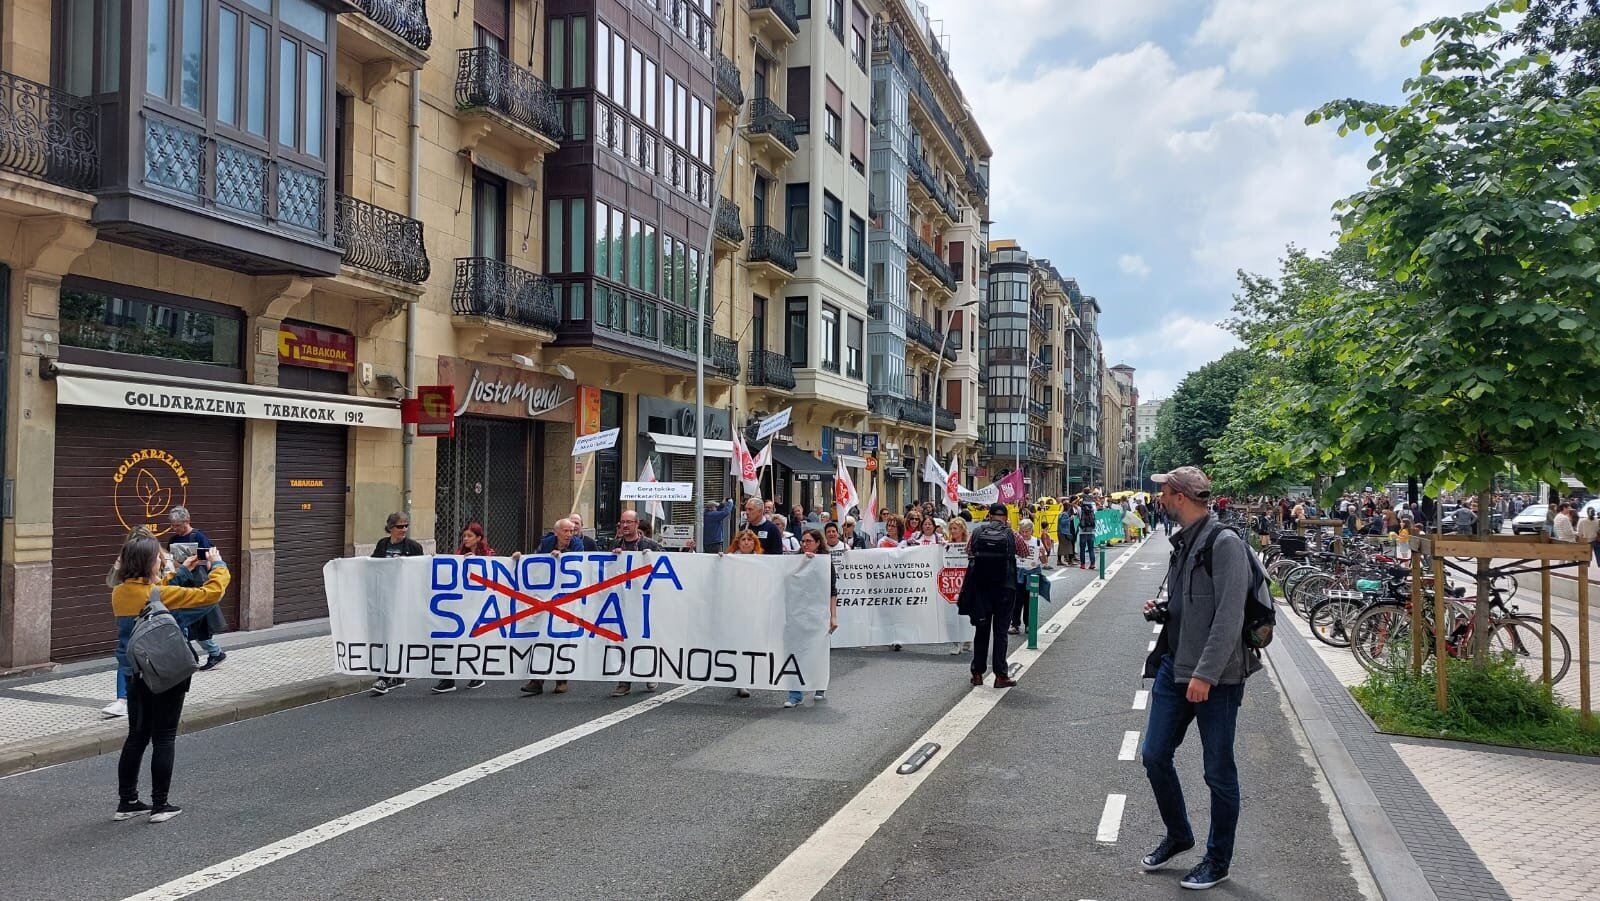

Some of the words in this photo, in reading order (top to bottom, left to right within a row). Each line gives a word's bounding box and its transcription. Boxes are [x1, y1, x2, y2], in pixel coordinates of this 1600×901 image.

[301, 344, 347, 360] TABAKOAK
[125, 391, 246, 415] GOLDARAZENA
[264, 403, 336, 421] TABAKOAK
[345, 411, 364, 423] 1912
[113, 448, 189, 486] GOLDARAZENA
[431, 554, 683, 591] DONOSTIA
[866, 571, 933, 580] DESAHUCIOS!
[942, 576, 964, 588] STO
[429, 592, 651, 639] SALGAI
[906, 596, 928, 606] EZ!!
[336, 641, 578, 675] RECUPEREMOS
[602, 645, 806, 686] DONOSTIA
